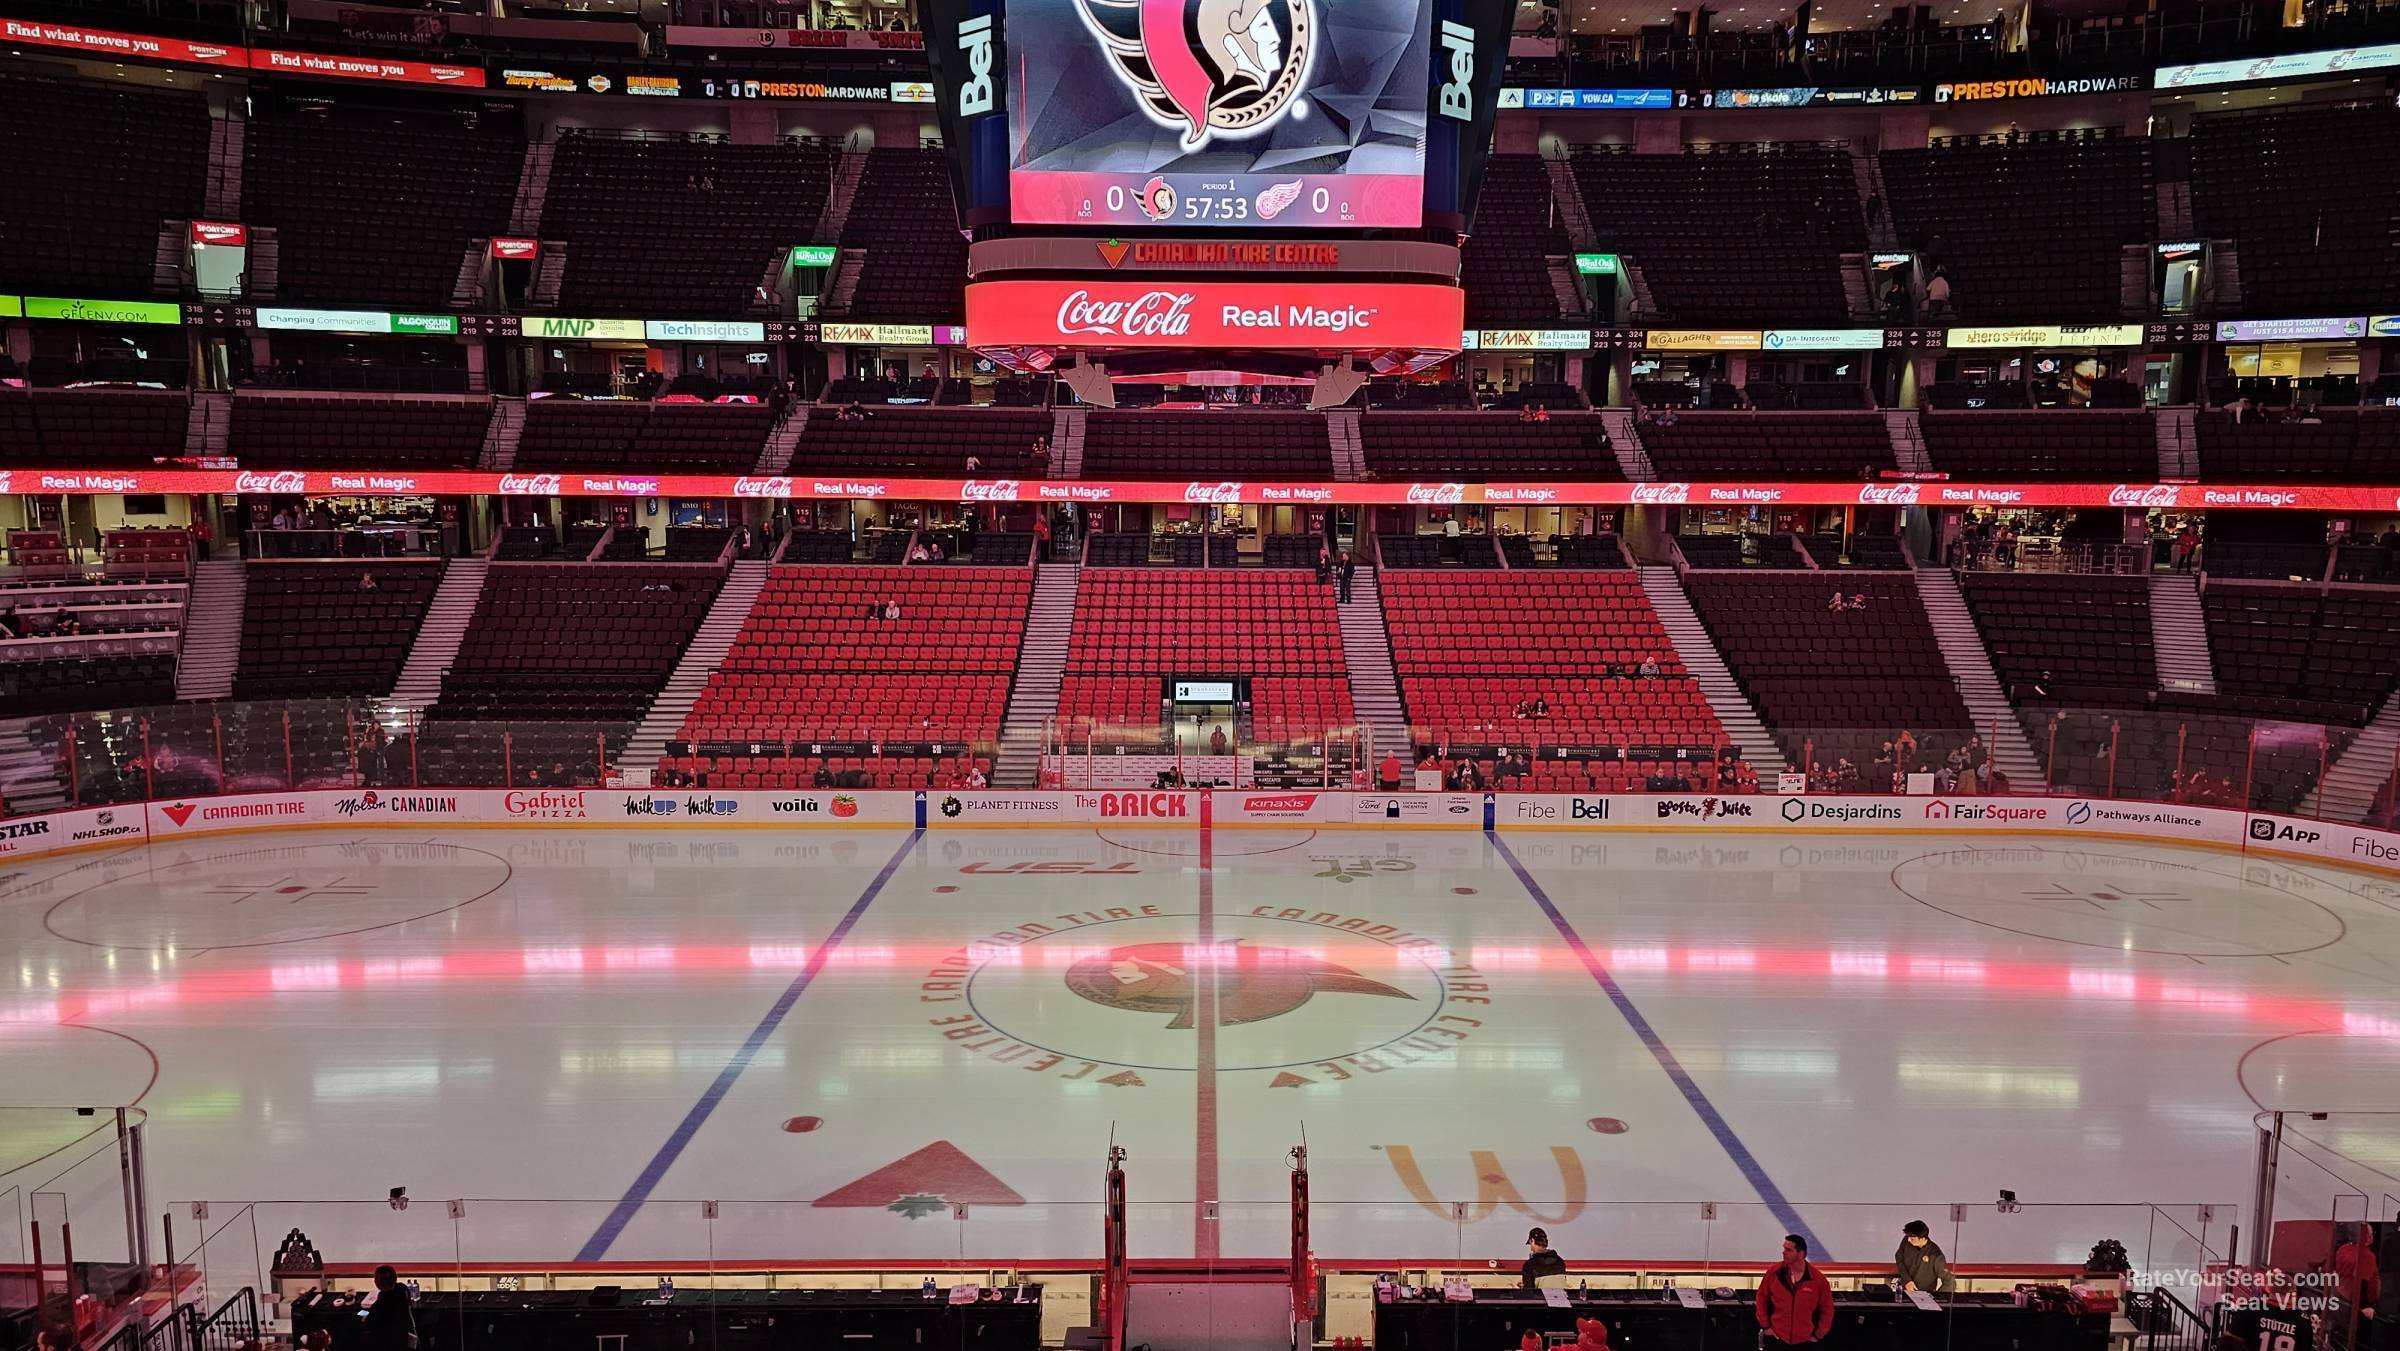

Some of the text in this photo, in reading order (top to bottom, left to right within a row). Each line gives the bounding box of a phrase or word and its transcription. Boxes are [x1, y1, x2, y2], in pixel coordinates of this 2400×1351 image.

[6, 22, 159, 54] Find what moves you
[377, 32, 397, 41] win
[399, 32, 409, 42] it
[759, 31, 847, 47] 18 BRIAN
[271, 53, 405, 77] Find what moves you
[959, 14, 993, 116] Bell
[1440, 20, 1475, 122] Bell
[1582, 92, 1614, 105] YOW.CA
[1761, 92, 1789, 104] skate
[1083, 199, 1091, 211] 0
[1106, 186, 1124, 211] 0
[1312, 188, 1330, 214] 0
[1185, 198, 1248, 219] 57:53
[1340, 202, 1348, 214] 0
[197, 225, 241, 236] SPORTCHEK
[496, 241, 534, 250] SPORTCHEK
[1134, 243, 1339, 264] CANADIAN TIRE CENTRE
[61, 307, 148, 323] GFLENV.COM
[187, 305, 251, 316] 318 319
[1056, 290, 1282, 336] Coca-Cola Real
[187, 316, 252, 327] 218 219
[269, 315, 376, 327] Changing Communities
[542, 320, 596, 337] MNP
[767, 323, 783, 331] 320
[2150, 323, 2211, 333] 325 326
[2258, 320, 2294, 328] STARTED
[2294, 319, 2320, 327] TODAY
[462, 327, 518, 336] 219 220
[659, 323, 750, 338] TechInsights
[804, 334, 818, 342] 221
[823, 325, 875, 341] RE/MAX
[878, 326, 930, 336] Hallmark
[1537, 332, 1588, 341] Hallmark
[1594, 330, 1644, 338] 323 324
[1887, 330, 1942, 338] 324 325
[2150, 332, 2210, 342] 225 226
[879, 336, 930, 344] Realty Group
[1483, 331, 1535, 348] RE/MAX
[1537, 340, 1589, 349] Realty Group
[1594, 340, 1643, 349] 223 224
[1659, 333, 1712, 345] GALLAGHER
[42, 477, 138, 492] Real Magic
[235, 471, 306, 493] Coca-Cola
[331, 477, 366, 489] Real
[499, 474, 561, 494] Coca-Cola
[583, 480, 614, 491] Real
[733, 476, 793, 497] Coca-Cola
[813, 483, 844, 494] Real
[961, 480, 1020, 500] Coca-Cola
[1039, 486, 1070, 497] Real
[1184, 482, 1244, 503] Coca-Cola
[1262, 487, 1291, 499] Real
[1406, 482, 1465, 504] Coca-Cola
[1485, 489, 1514, 500] Real
[1630, 483, 1690, 504] Coca-Cola
[1710, 488, 1740, 500] Real
[1859, 483, 1921, 504] Coca-Cola
[1942, 489, 1977, 501] Real
[2108, 485, 2183, 506] Coca-Cola
[2204, 491, 2242, 503] Real
[202, 801, 306, 820] CANADIAN TIRE
[333, 796, 457, 817] Molson CANADIAN
[504, 791, 586, 814] Gabriel
[772, 797, 819, 812] voilà
[967, 800, 1060, 812] PLANET FITNESS
[1074, 793, 1189, 818] The BRICK
[1358, 799, 1382, 811] Ford
[1518, 801, 1556, 819] Fibe
[1571, 798, 1610, 820] Bell
[1657, 800, 1753, 818] Booster Juice
[530, 809, 587, 818] PIZZA
[1810, 803, 1902, 822] Desjardins
[1953, 804, 2047, 823] FairSquare
[2095, 809, 2202, 827] Pathways Alliance
[2351, 836, 2400, 861] Fibe
[1056, 905, 1163, 925] TIRE
